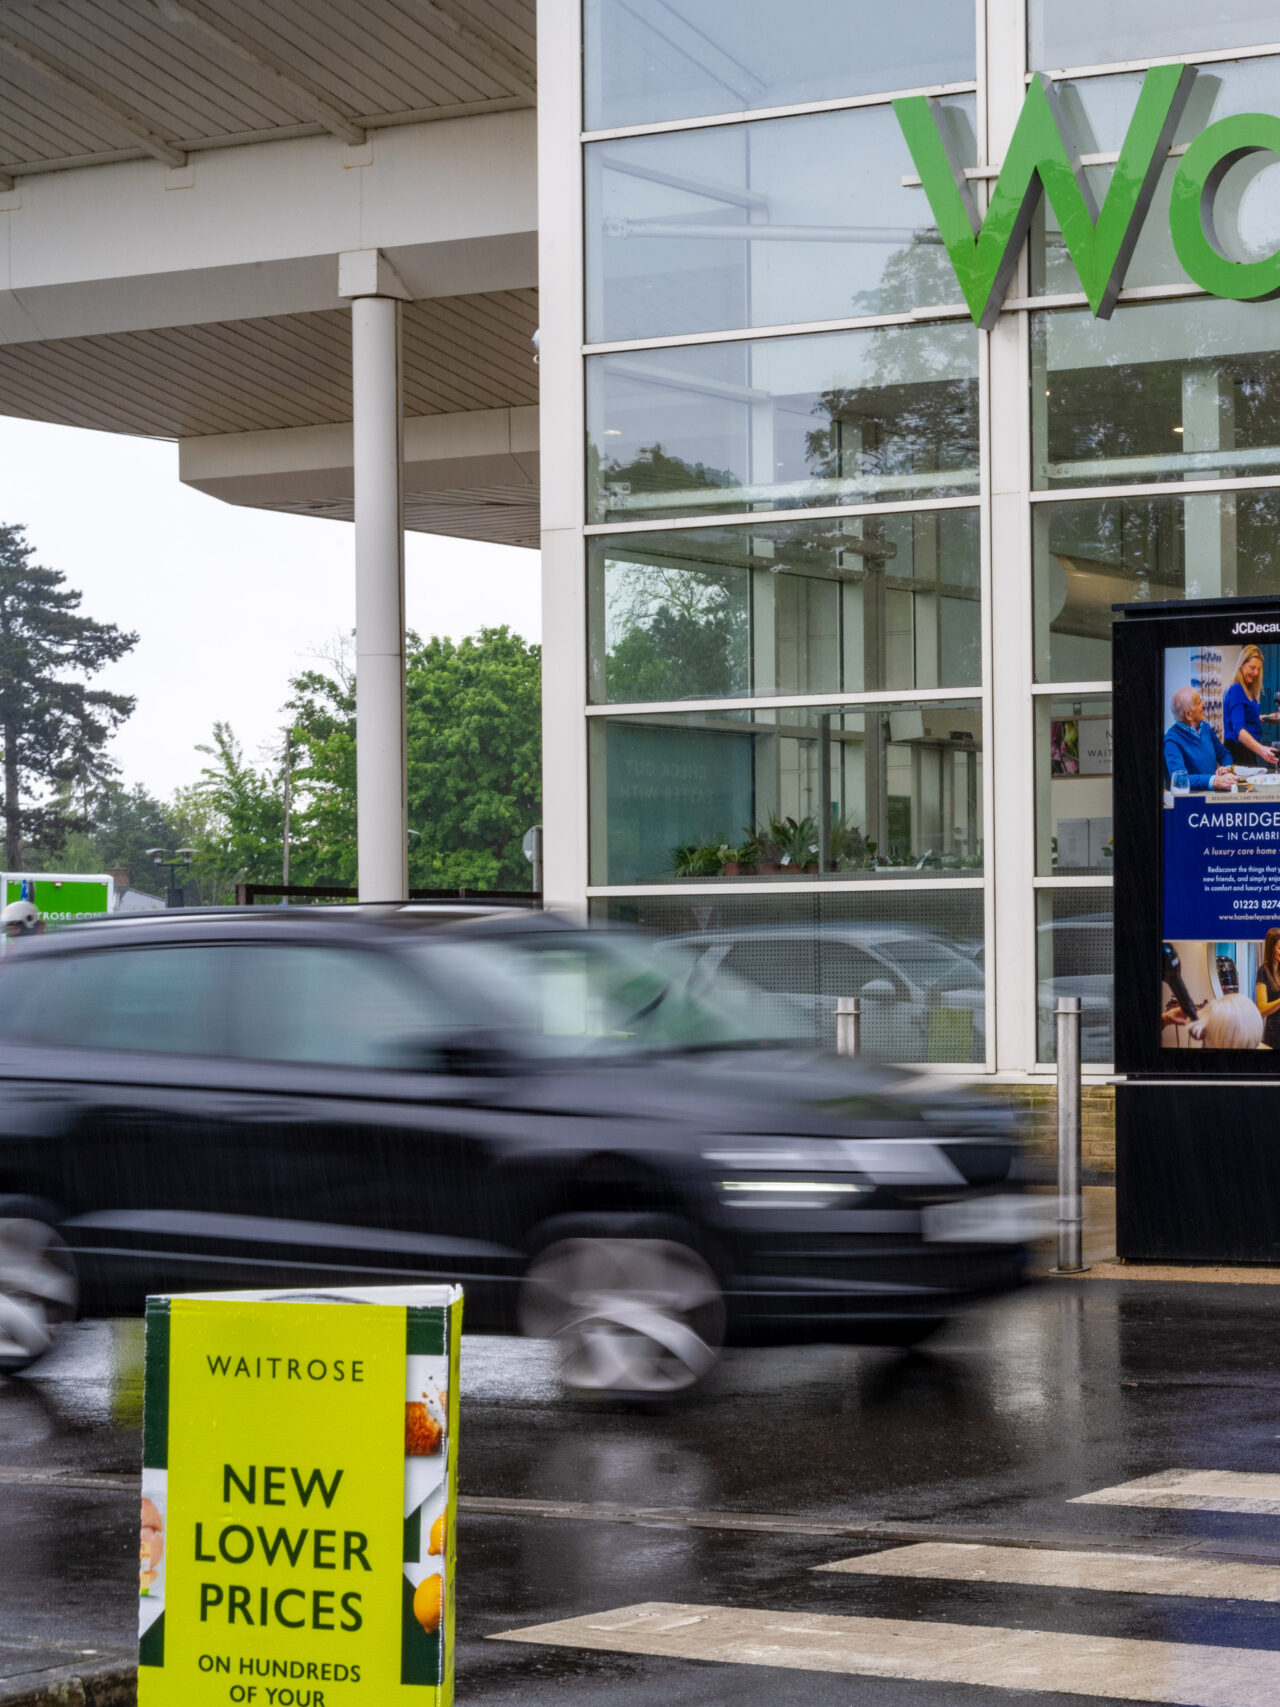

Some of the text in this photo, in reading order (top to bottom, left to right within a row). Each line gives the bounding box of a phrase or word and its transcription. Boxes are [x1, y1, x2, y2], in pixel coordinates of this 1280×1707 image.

[1188, 812, 1280, 828] CAMBRIDGE
[1227, 832, 1239, 841] IN
[1211, 847, 1235, 857] luxury
[1256, 846, 1276, 855] home
[1208, 865, 1237, 873] Rediscover
[1238, 865, 1247, 873] the
[1248, 865, 1265, 874] things
[1215, 874, 1236, 883] friends,
[1237, 874, 1249, 882] and
[1249, 875, 1267, 883] simply
[1245, 884, 1263, 893] luxury
[1233, 900, 1259, 909] 01223
[206, 1354, 365, 1382] WAITROSE
[222, 1463, 344, 1509] NEW
[194, 1522, 373, 1572] LOWER
[199, 1582, 363, 1632] PRICES
[198, 1654, 361, 1683] ON HUNDREDS
[229, 1684, 326, 1707] OF YOUR
